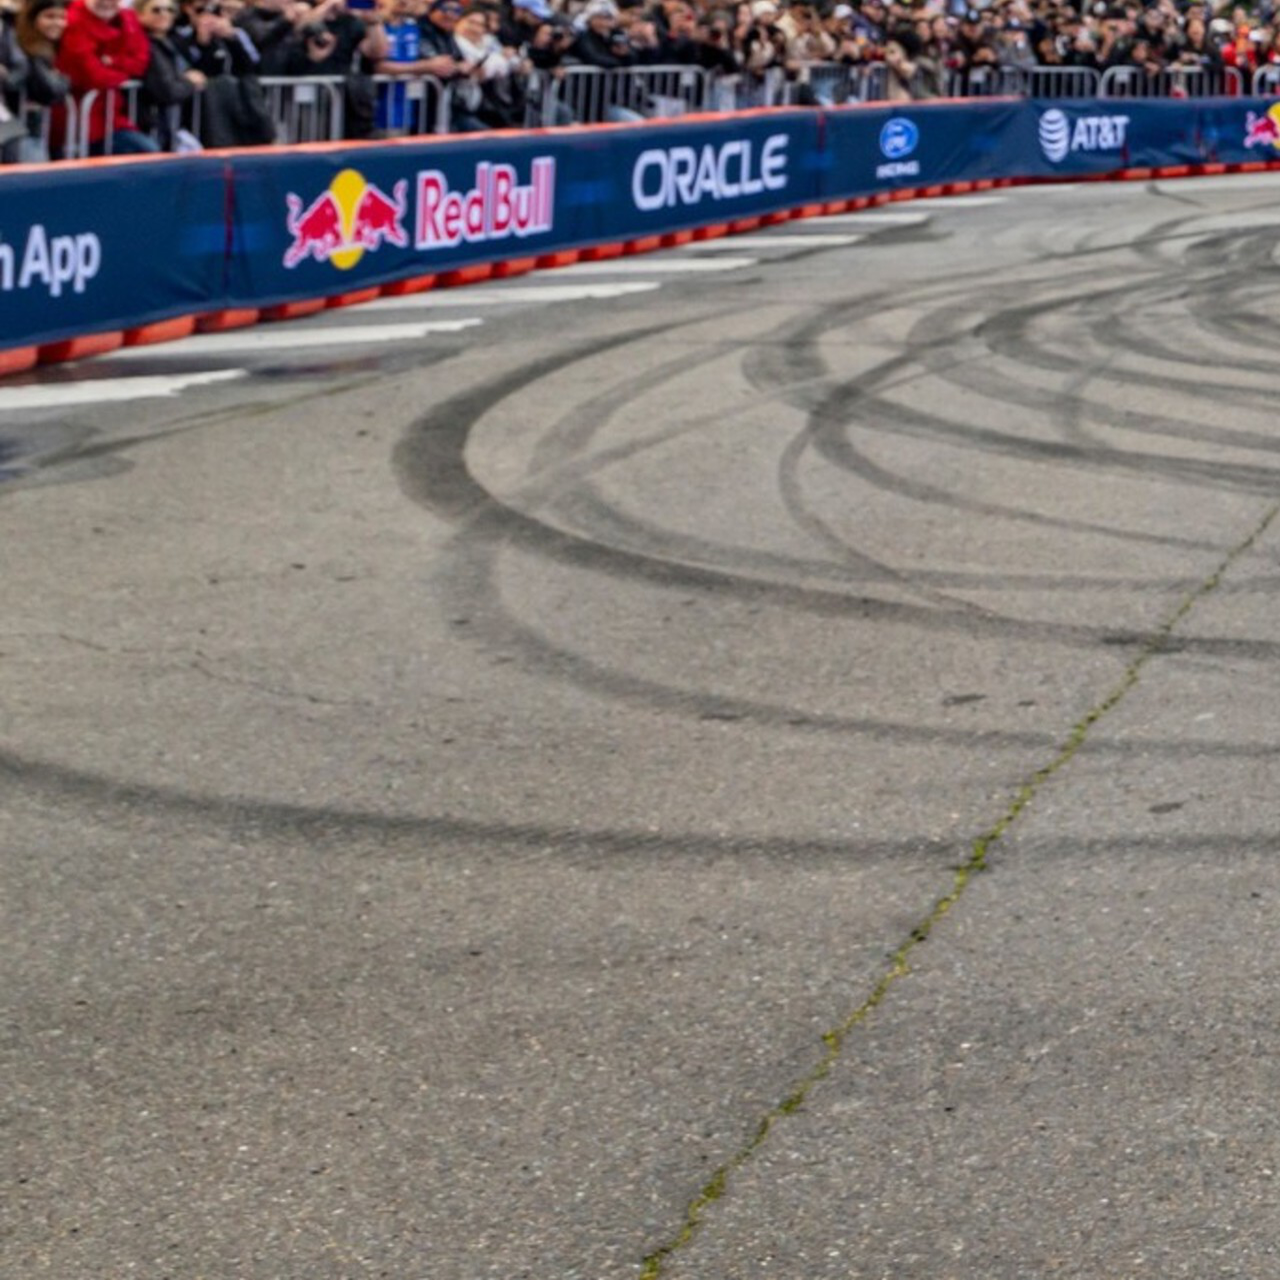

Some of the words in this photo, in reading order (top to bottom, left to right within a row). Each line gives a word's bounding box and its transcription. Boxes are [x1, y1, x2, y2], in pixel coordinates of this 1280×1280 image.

[1071, 114, 1131, 151] AT&T
[415, 161, 490, 249] Red
[492, 156, 556, 236] Bull
[632, 134, 789, 211] ORACLE
[18, 224, 102, 297] App
